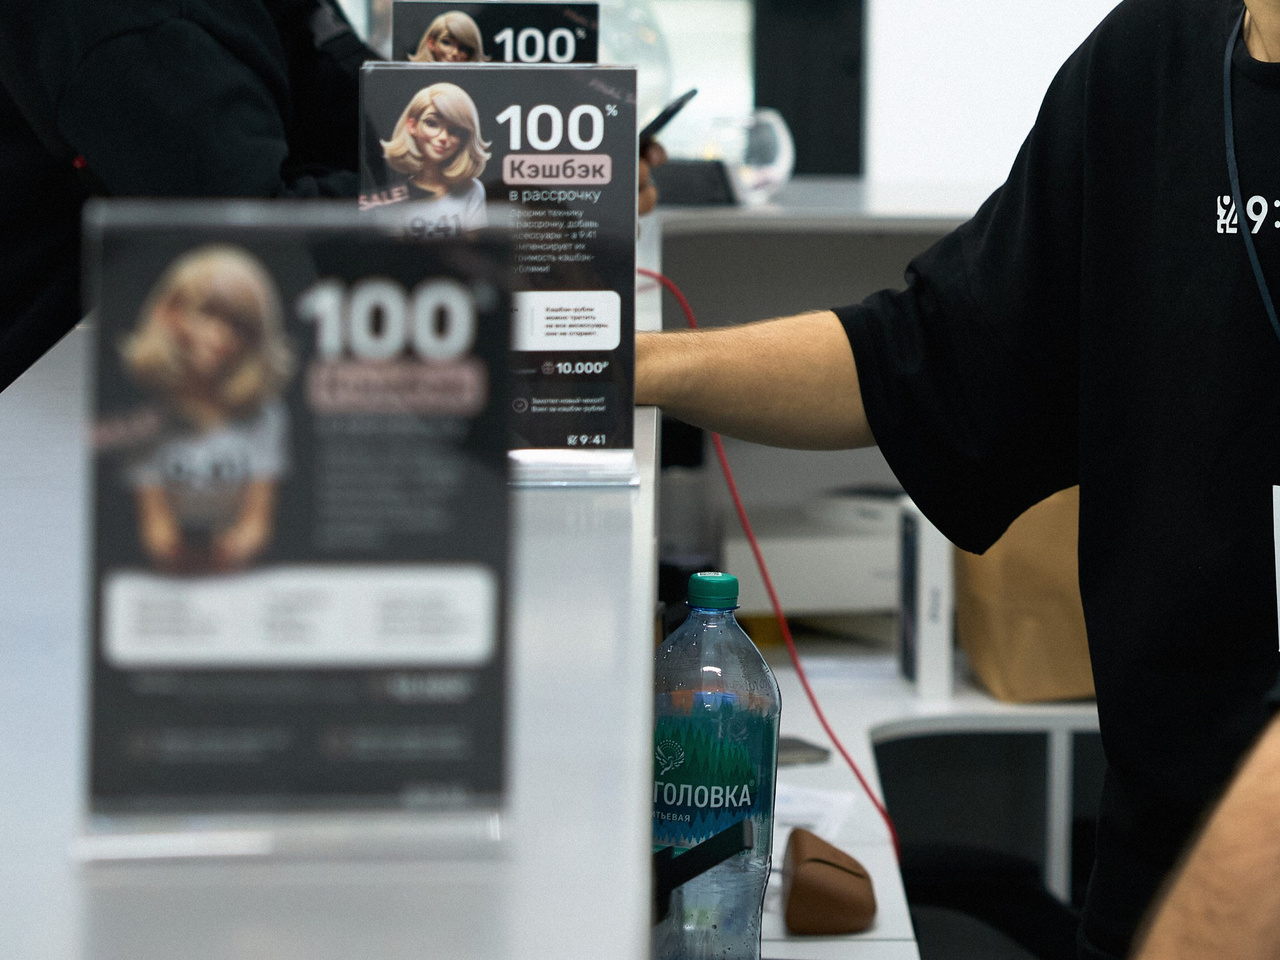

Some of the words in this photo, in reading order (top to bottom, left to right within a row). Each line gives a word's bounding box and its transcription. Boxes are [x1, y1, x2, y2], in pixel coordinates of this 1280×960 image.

[495, 104, 618, 151] 100%
[510, 159, 605, 179] Кэшбэк
[509, 190, 519, 201] в
[521, 190, 602, 205] рассрочку
[513, 231, 562, 241] ксессуары
[513, 242, 573, 253] омпенсирует
[514, 253, 557, 262] тоимость
[513, 264, 551, 275] ублями!
[579, 434, 606, 446] 9:41
[653, 780, 752, 808] ГОЛОВКА
[652, 810, 691, 822] ИТЬЕВАЯ
